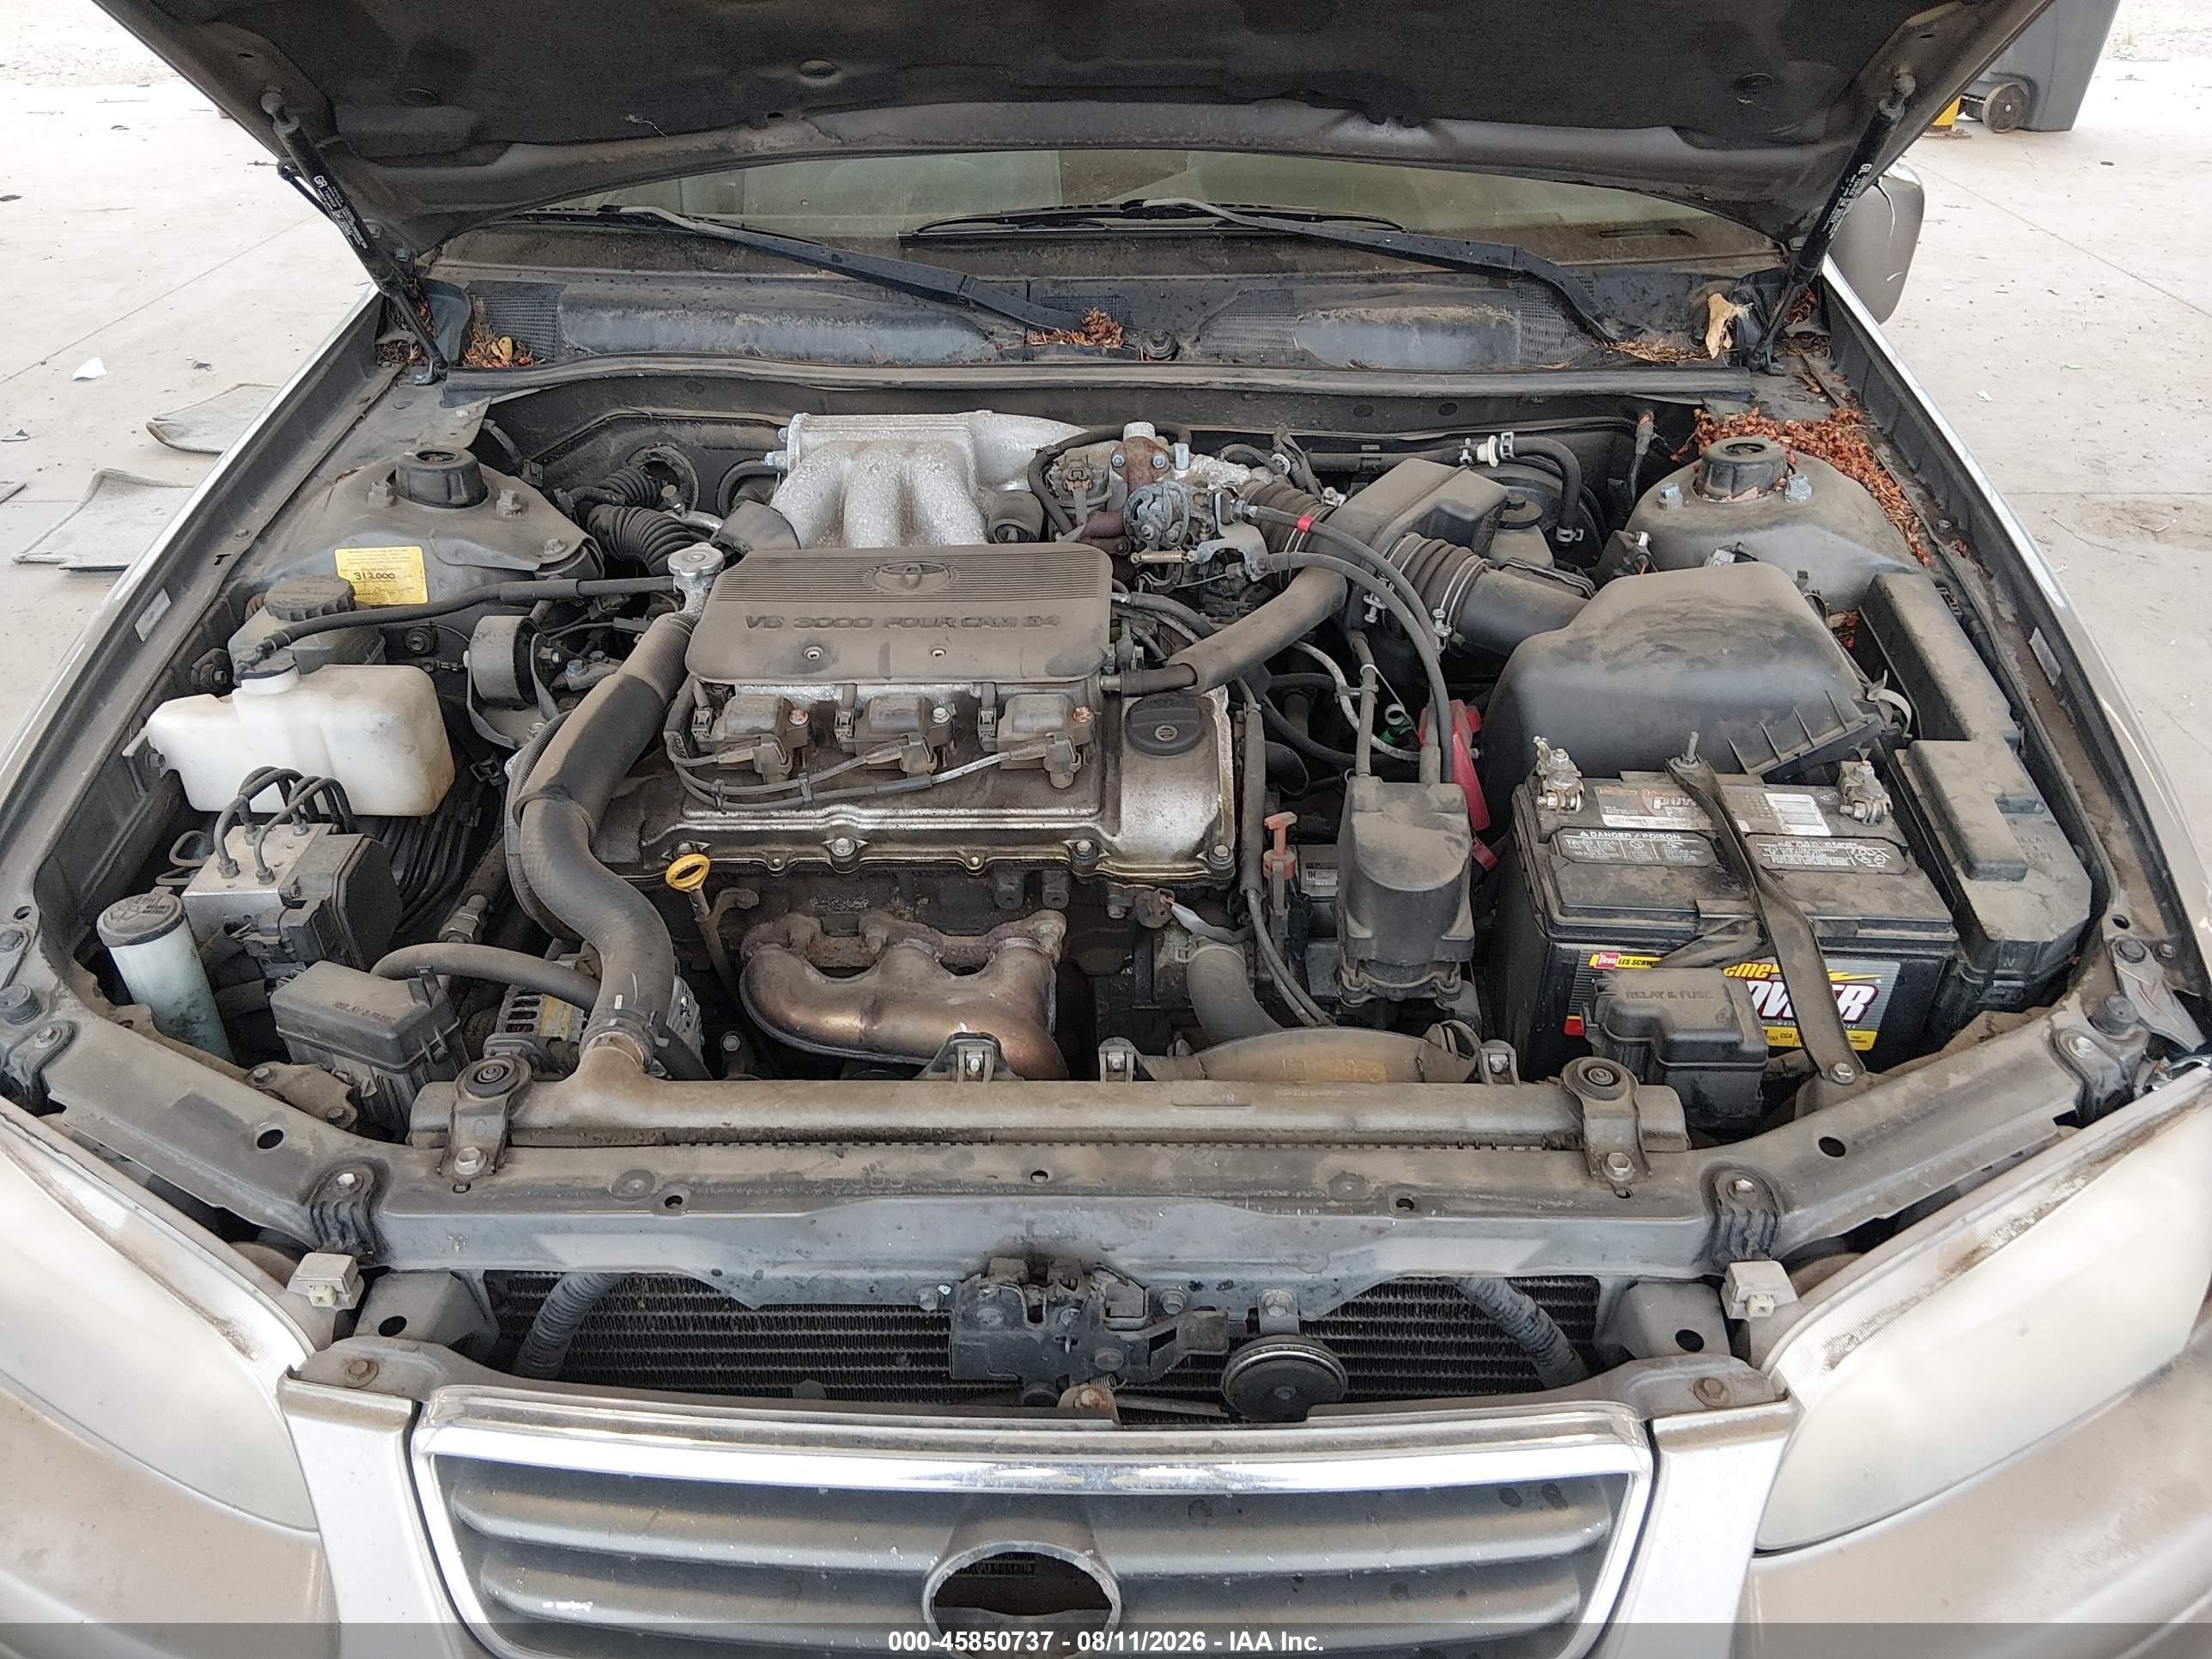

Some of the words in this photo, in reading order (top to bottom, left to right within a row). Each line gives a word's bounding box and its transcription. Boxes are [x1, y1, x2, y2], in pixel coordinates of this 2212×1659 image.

[793, 617, 873, 629] 3000
[883, 617, 957, 629] FOUR
[1626, 990, 1664, 1000] RELAY
[1680, 991, 1715, 1000] FUSE
